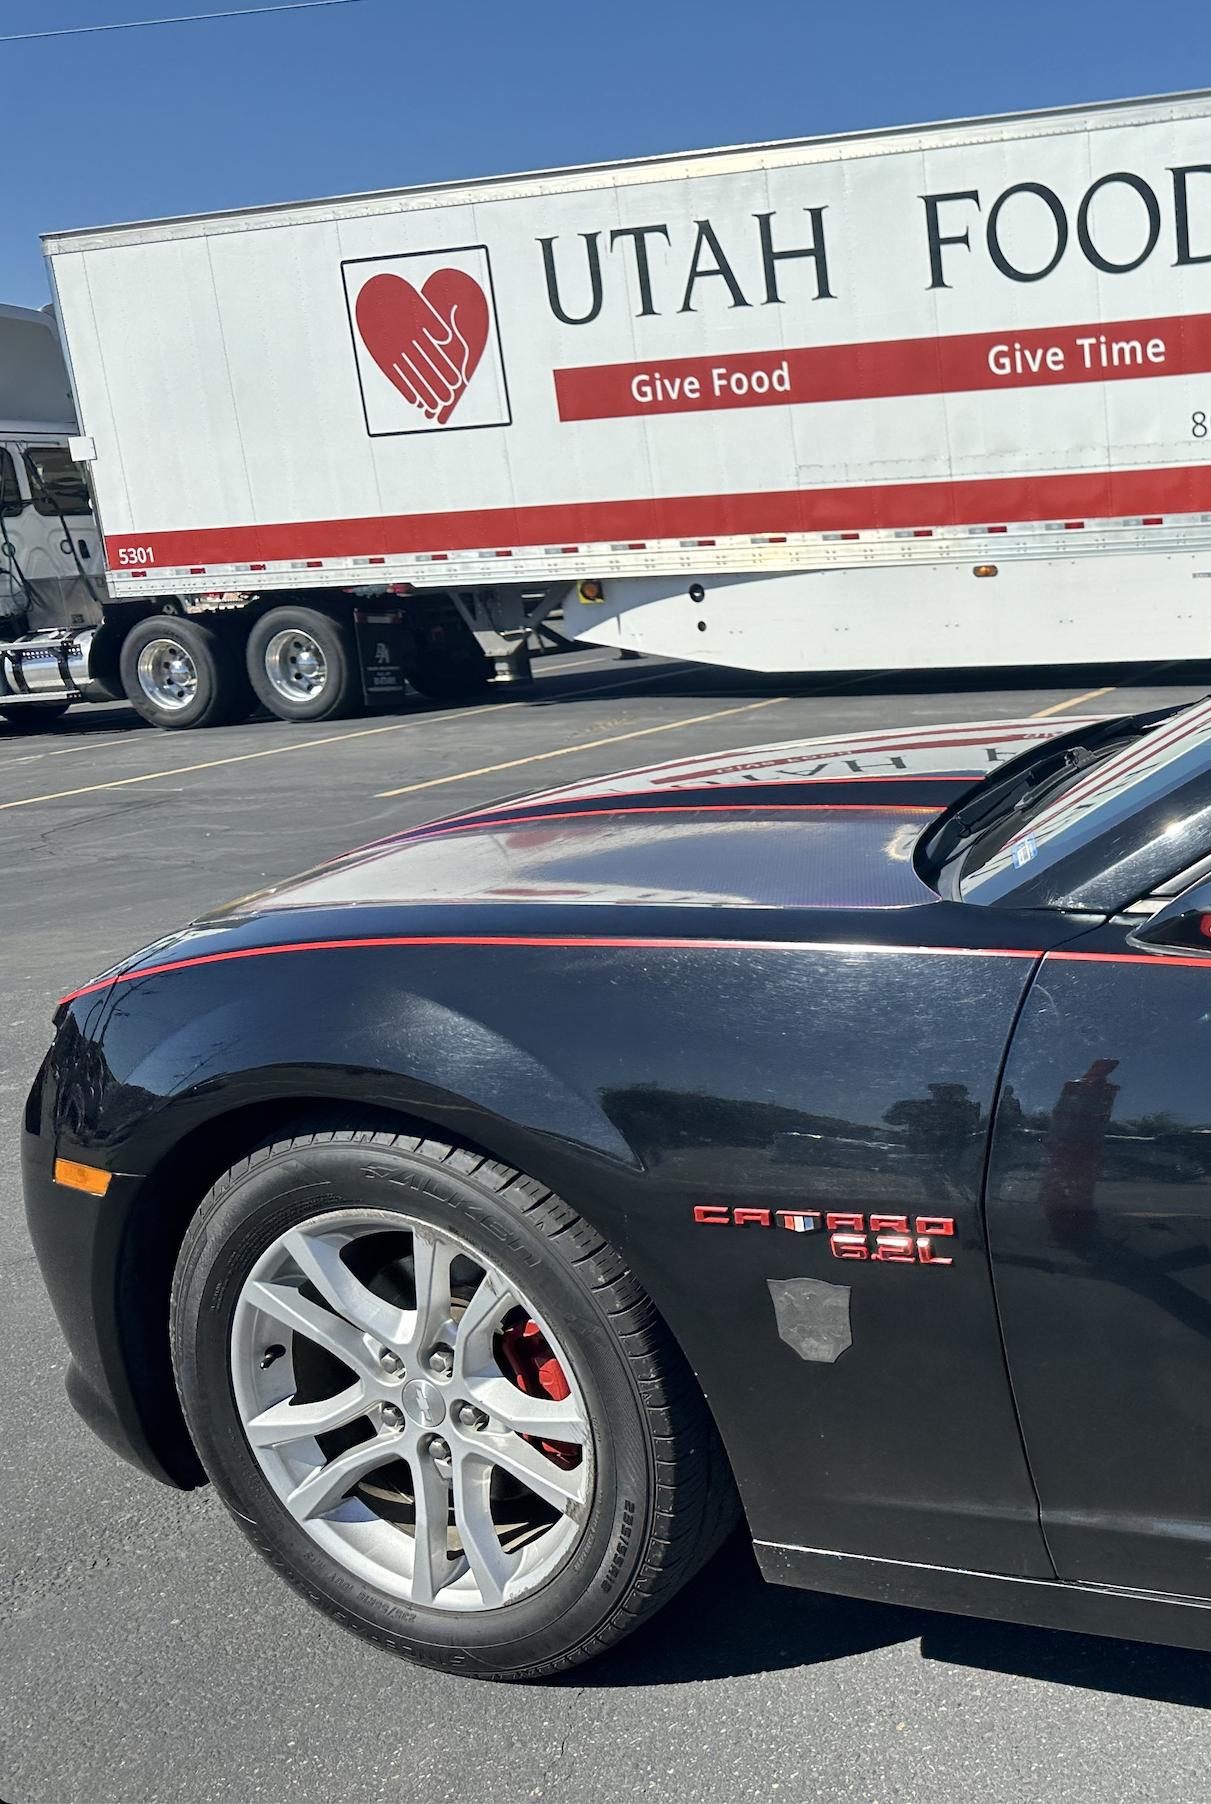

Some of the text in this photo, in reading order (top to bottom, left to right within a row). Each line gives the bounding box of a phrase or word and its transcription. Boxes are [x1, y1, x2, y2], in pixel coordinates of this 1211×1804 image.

[535, 204, 837, 325] UTAH
[987, 334, 1166, 377] Give Time
[631, 361, 791, 404] Give Food
[118, 546, 155, 565] 5301
[830, 1233, 953, 1265] 6.2L
